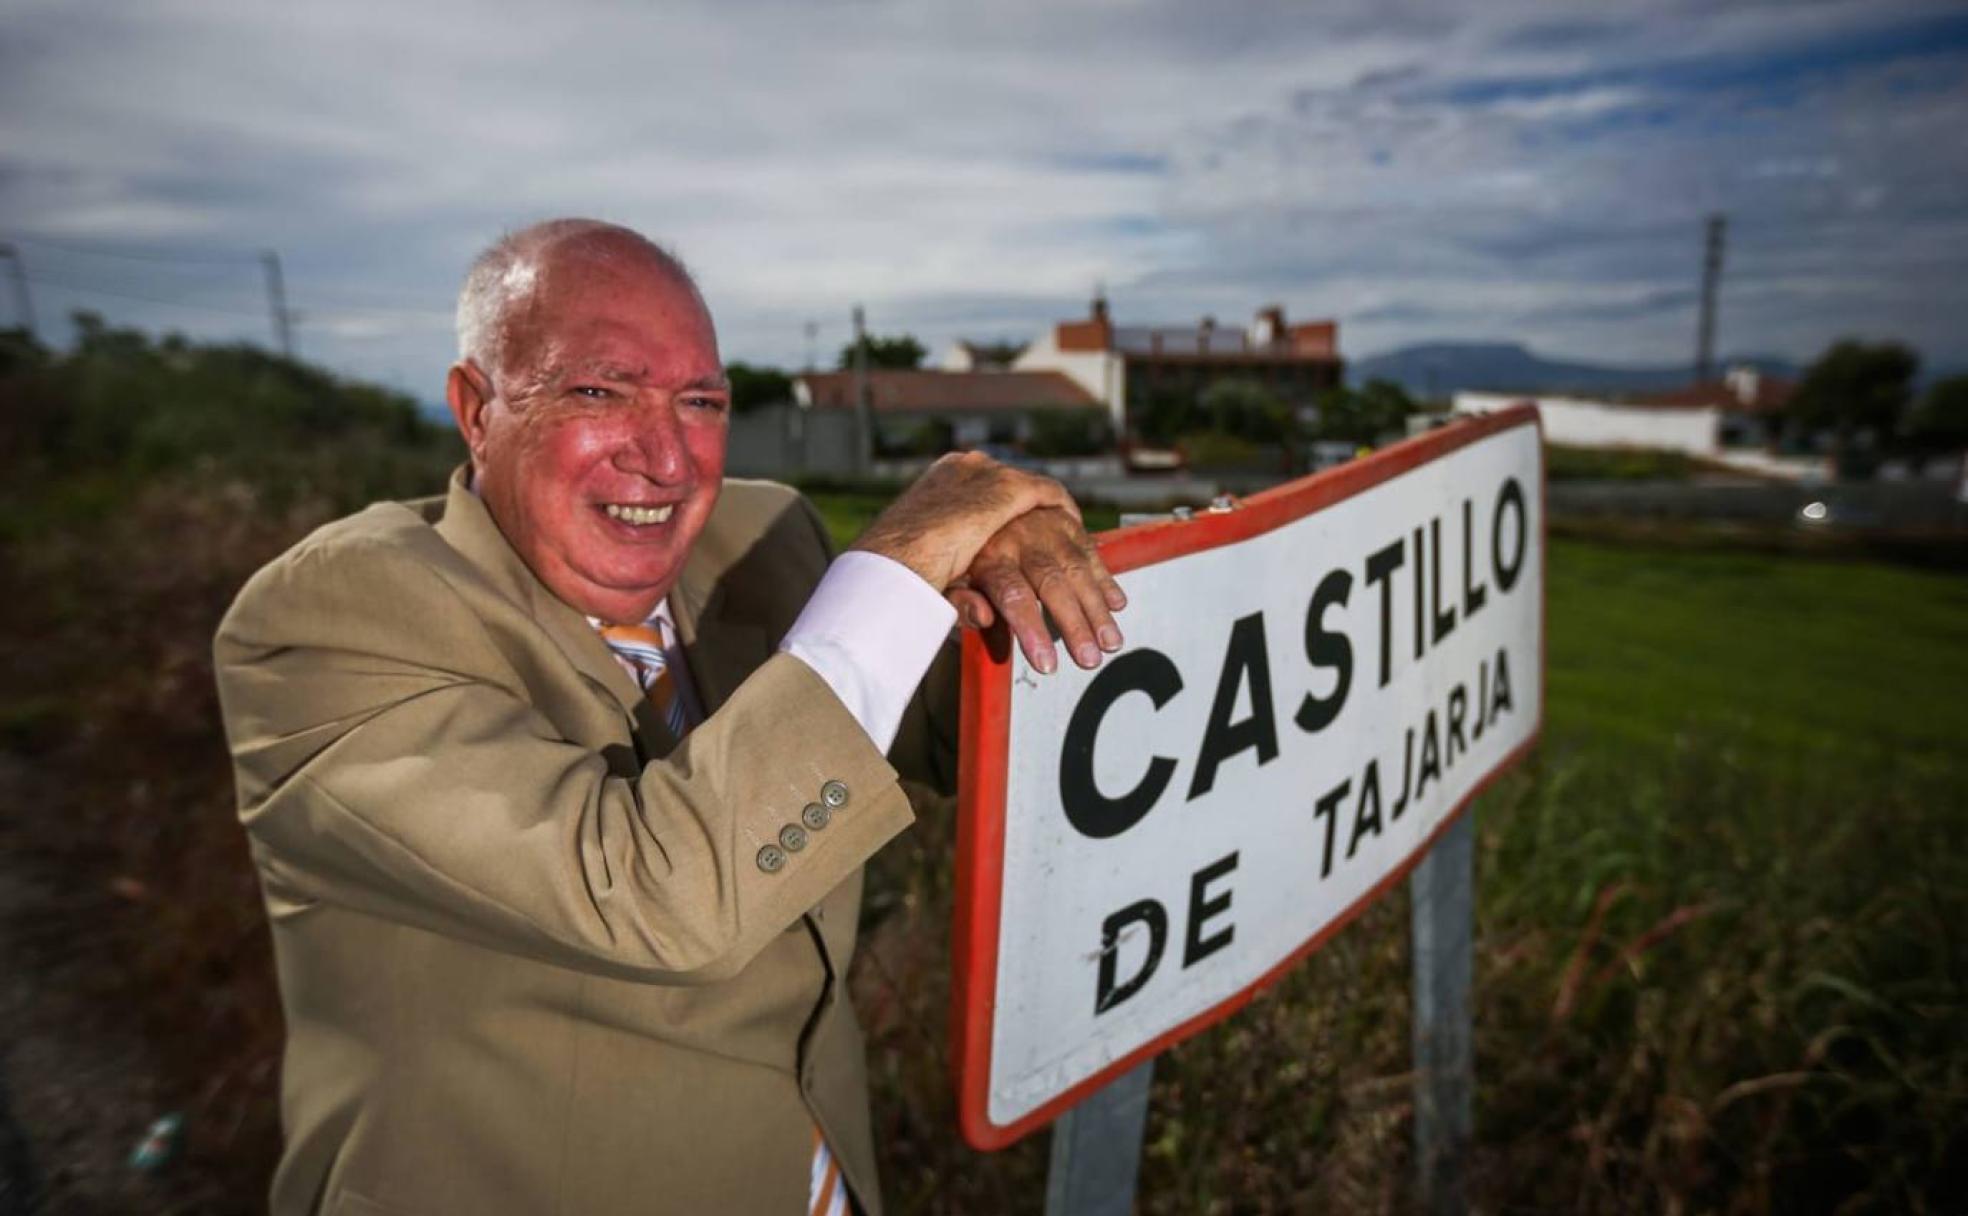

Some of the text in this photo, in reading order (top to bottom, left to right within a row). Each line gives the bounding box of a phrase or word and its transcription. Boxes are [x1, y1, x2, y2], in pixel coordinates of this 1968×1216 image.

[1058, 475, 1528, 841] CASTILLO
[1094, 647, 1514, 1018] DE TAJARJA
